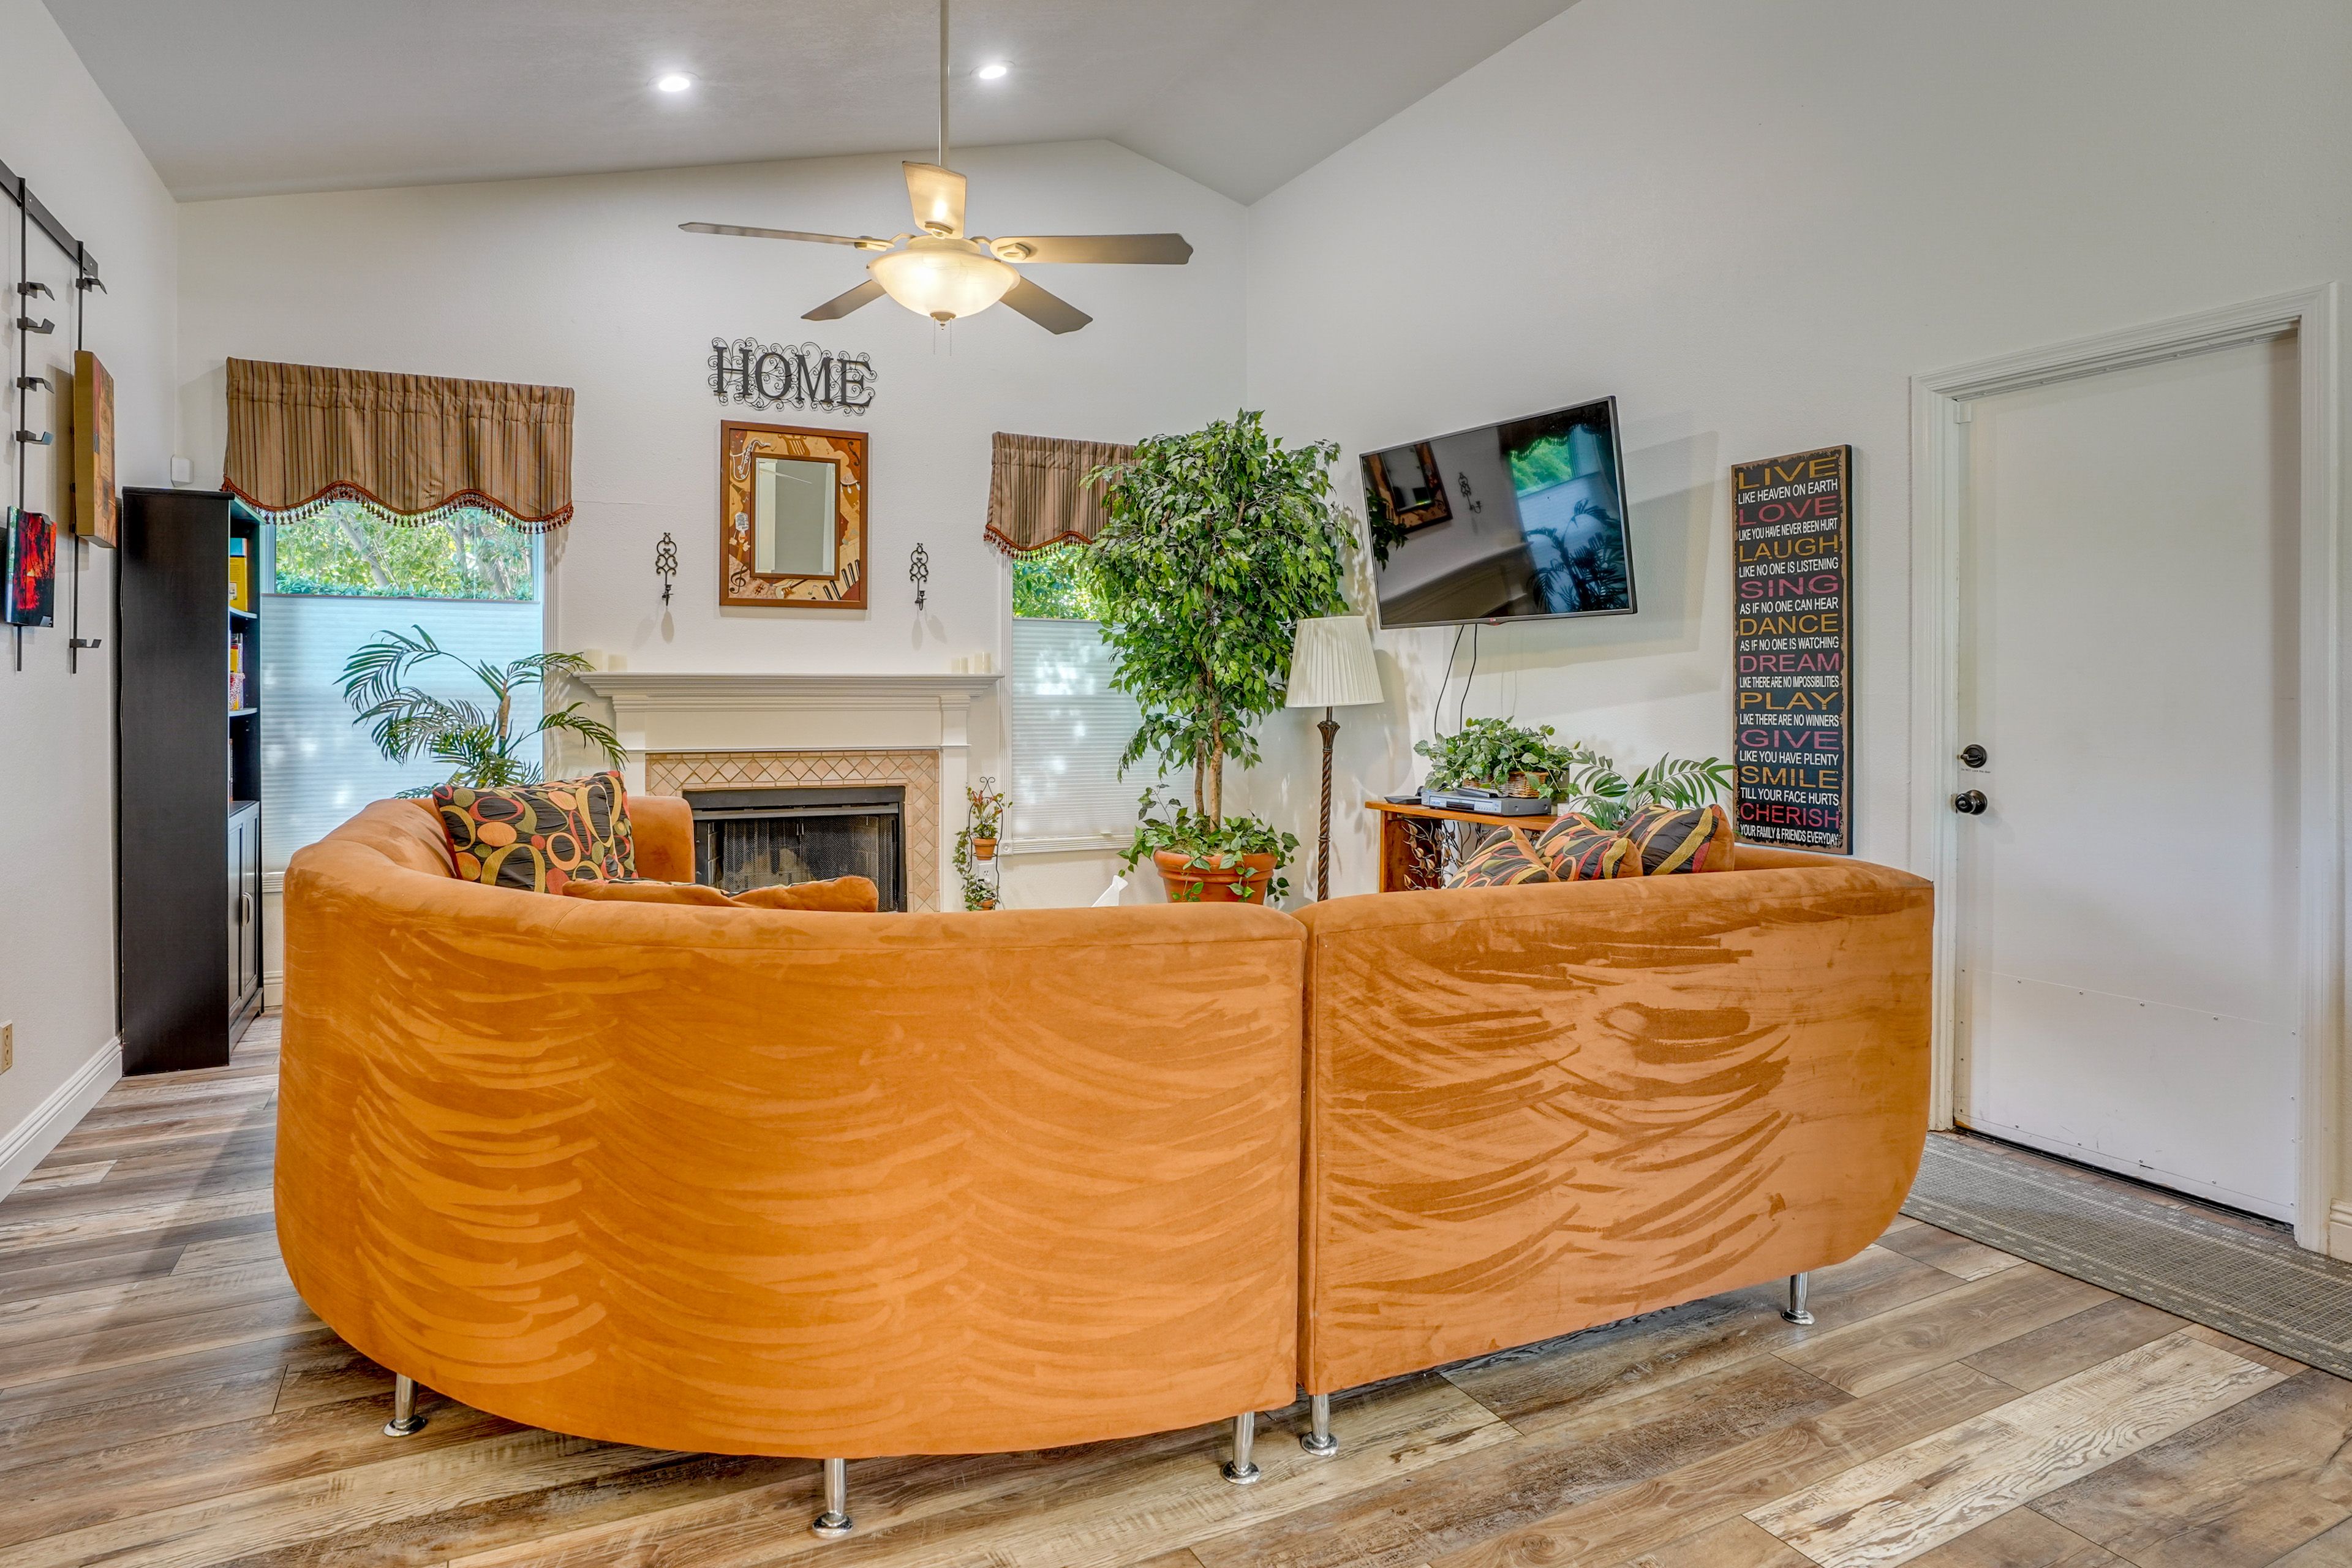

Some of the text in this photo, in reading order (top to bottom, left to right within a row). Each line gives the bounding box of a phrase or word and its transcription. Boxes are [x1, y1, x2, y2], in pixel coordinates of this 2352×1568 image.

[713, 345, 873, 407] HOME
[1739, 456, 1837, 489] LIVE
[1738, 478, 1838, 504] LIKE HEAVEN ON EARTH
[1739, 495, 1838, 526] LOVE
[1739, 518, 1838, 541] LIKE YOU HAVE NEVER BEEN HURT
[1739, 535, 1838, 562] LAUGH
[1739, 557, 1839, 578] LIKE NO ONE IS LISTENING
[1740, 575, 1839, 599] SING
[1740, 597, 1839, 614] AS IF NO ONE CAN HEAR
[1740, 613, 1839, 636] DANCE
[1740, 636, 1839, 651] AS IF NO ONE IS WATCHING
[1740, 653, 1839, 673] DREAM
[1740, 676, 1839, 688] LIKE THERE ARE NO IMPOSSIBILITIES
[1740, 692, 1839, 710] PLAY
[1740, 714, 1839, 726] LIKE THERE ARE NO WINNERS
[1741, 729, 1839, 750] GIVE
[1740, 750, 1839, 766] LIKE YOU HAVE PLENTY
[1741, 766, 1839, 789] SMILE
[1740, 787, 1839, 806] TILL YOUR FACE HURTS
[1740, 803, 1840, 829] CHERISH
[1740, 824, 1839, 845] YOUR FAMILY & FRIENDS EVERYDAY
